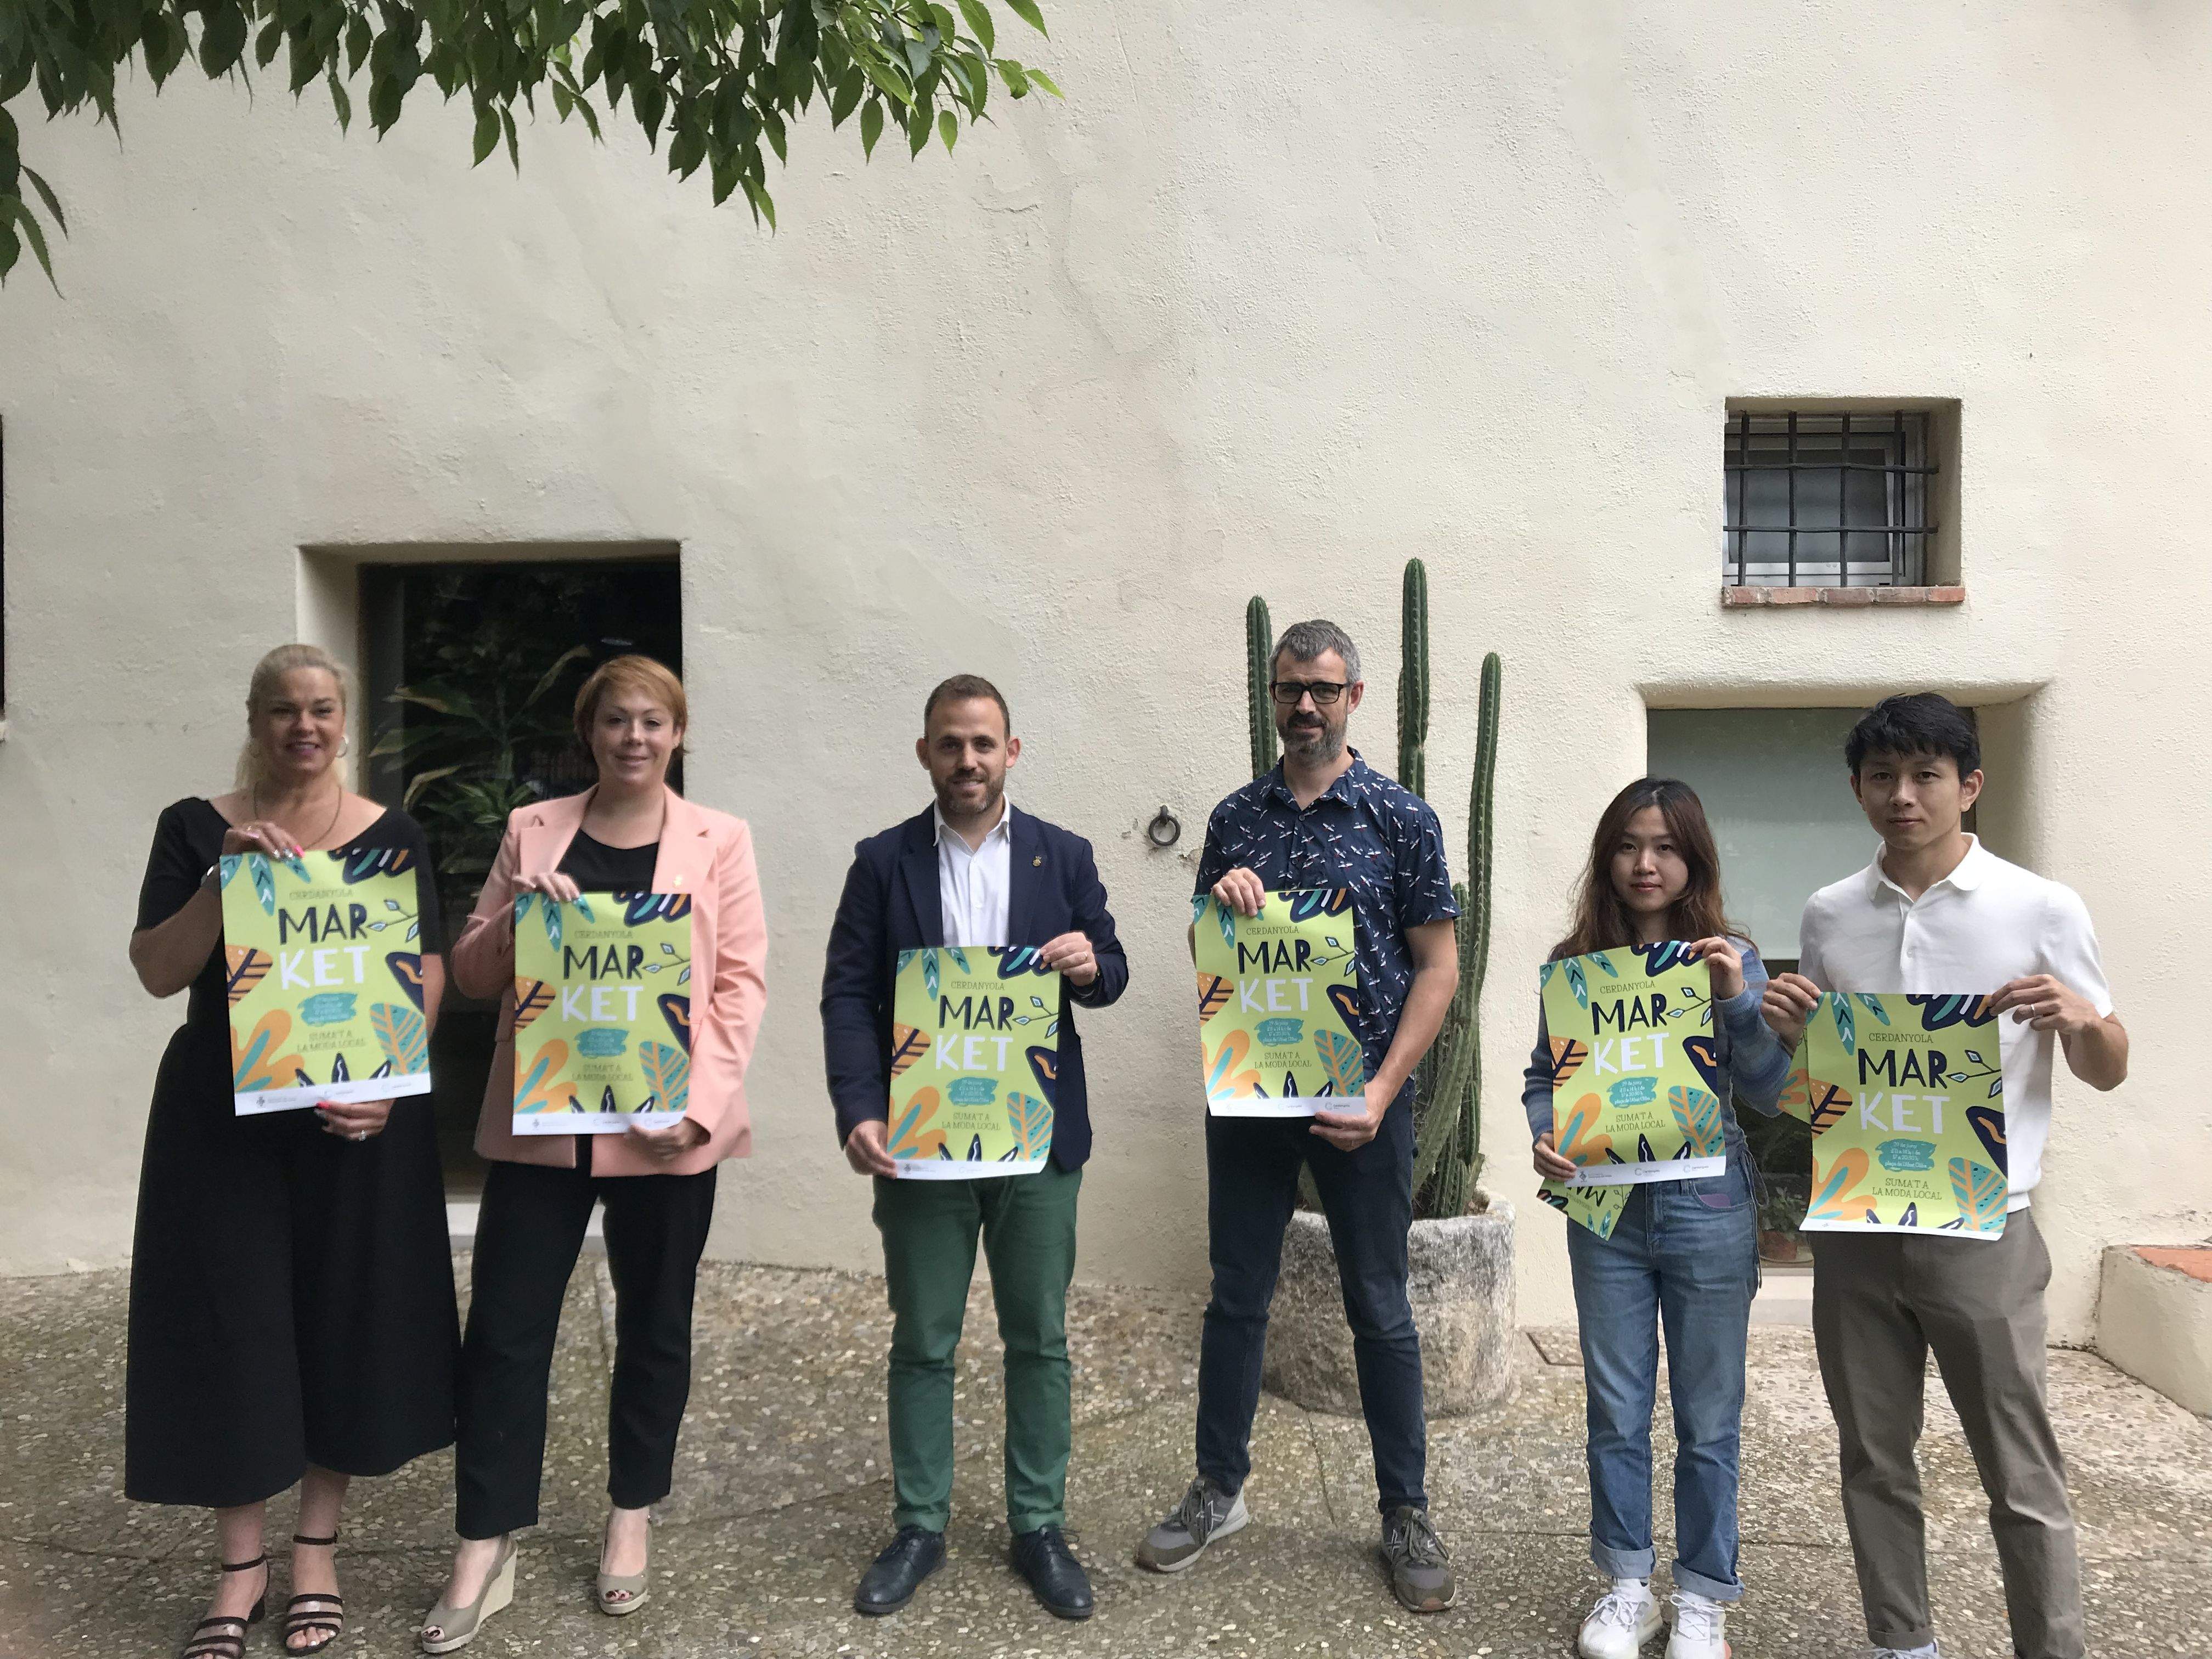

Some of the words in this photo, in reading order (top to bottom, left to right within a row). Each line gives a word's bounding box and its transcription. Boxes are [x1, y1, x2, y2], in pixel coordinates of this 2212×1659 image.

[278, 904, 368, 945] MAR
[1246, 926, 1299, 935] CERDANYOLA
[279, 945, 371, 990] KET
[563, 944, 644, 981] MAR
[1238, 939, 1311, 975] MAR
[561, 984, 645, 1022] KET
[951, 981, 1005, 990] CERDANYOLA
[1239, 977, 1313, 1014] KET
[1600, 980, 1655, 994] CERDANYOLA
[939, 995, 1014, 1031] MAR
[1592, 994, 1667, 1035] MAR
[935, 1032, 1014, 1072] KET
[1594, 1032, 1670, 1076] KET
[1869, 1033, 1934, 1043] CERDANYOLA
[1265, 1060, 1288, 1068] MODA
[1288, 1059, 1312, 1068] LOCAL
[1858, 1048, 1948, 1089] MAR
[953, 1121, 975, 1130] MODA
[1605, 1125, 1615, 1133] LA
[1617, 1122, 1640, 1132] MODA
[1641, 1119, 1666, 1130] LOCAL
[1648, 1111, 1654, 1119] A
[1859, 1092, 1950, 1134] KET
[1872, 1187, 1883, 1196] LA
[1885, 1188, 1911, 1198] MODA
[1914, 1190, 1942, 1200] LOCAL
